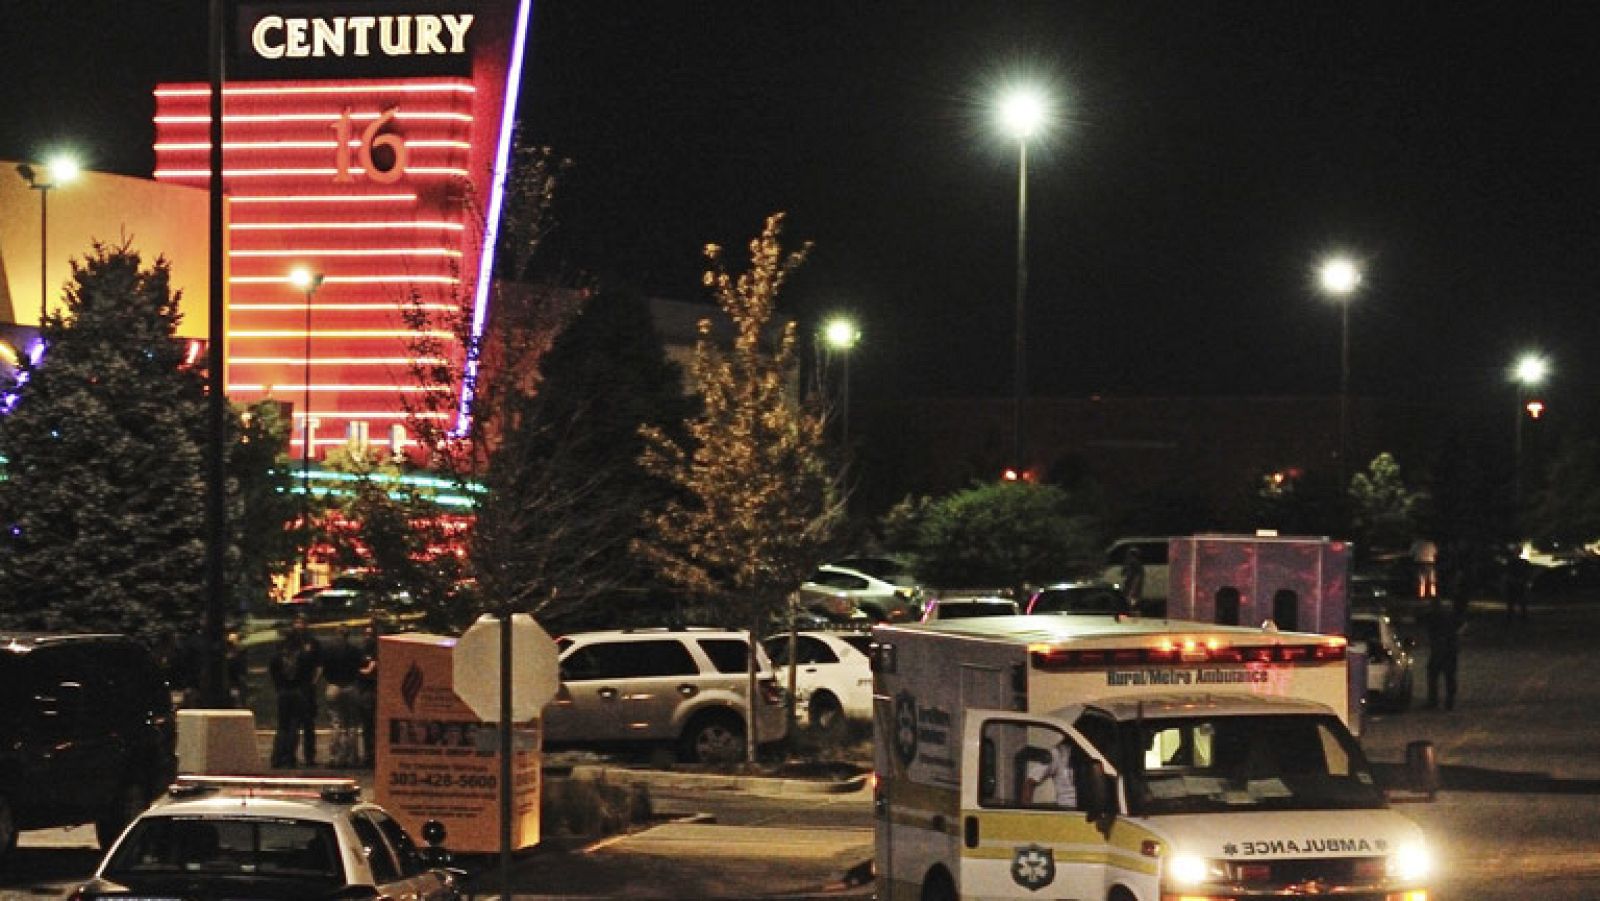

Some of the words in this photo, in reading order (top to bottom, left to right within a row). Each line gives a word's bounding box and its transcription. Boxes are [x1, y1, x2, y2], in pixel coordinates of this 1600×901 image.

[252, 14, 474, 59] CENTURY
[331, 106, 406, 183] 16
[1196, 667, 1268, 684] Ambulance
